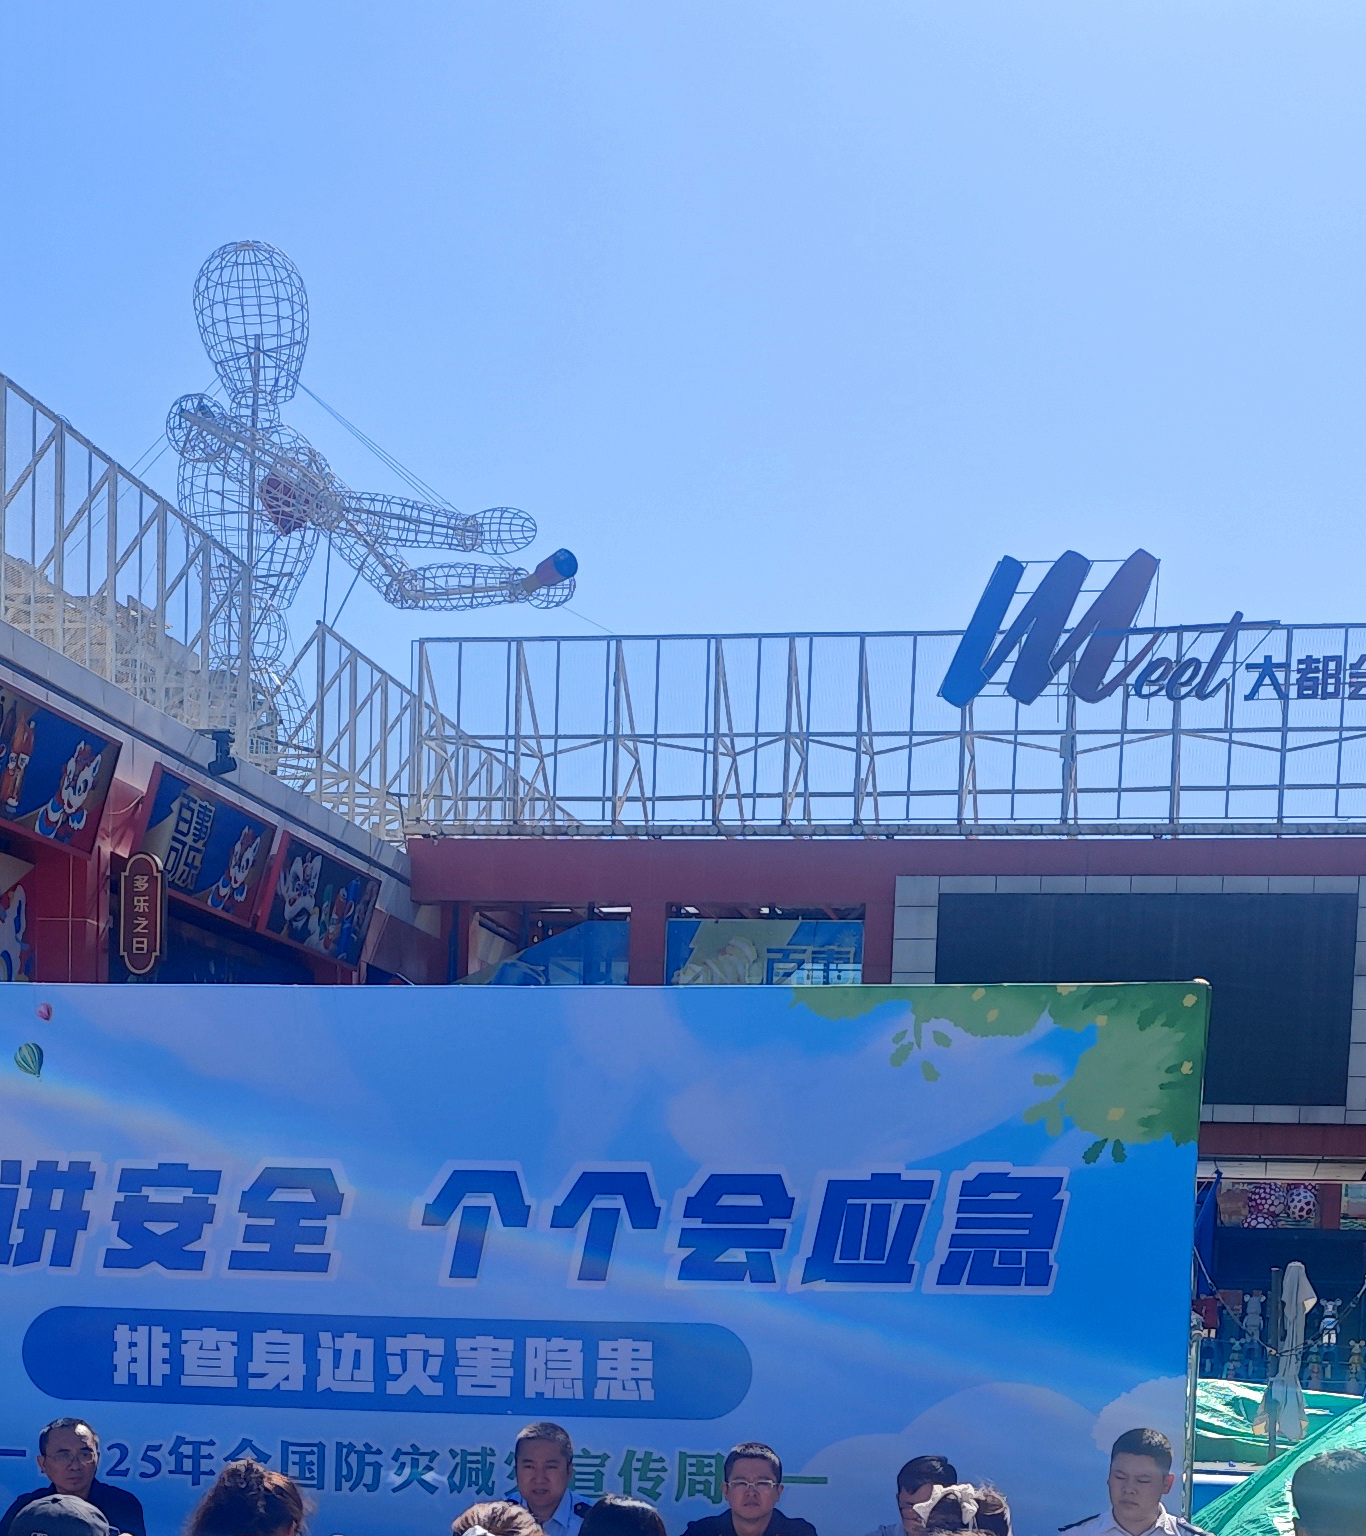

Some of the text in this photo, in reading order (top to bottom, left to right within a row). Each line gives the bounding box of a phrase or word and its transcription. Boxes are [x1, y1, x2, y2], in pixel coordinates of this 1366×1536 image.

[130, 873, 152, 956] 多乐之日
[421, 1166, 1068, 1289] 个个会应急
[112, 1323, 656, 1402] 排查身边灾害隐患
